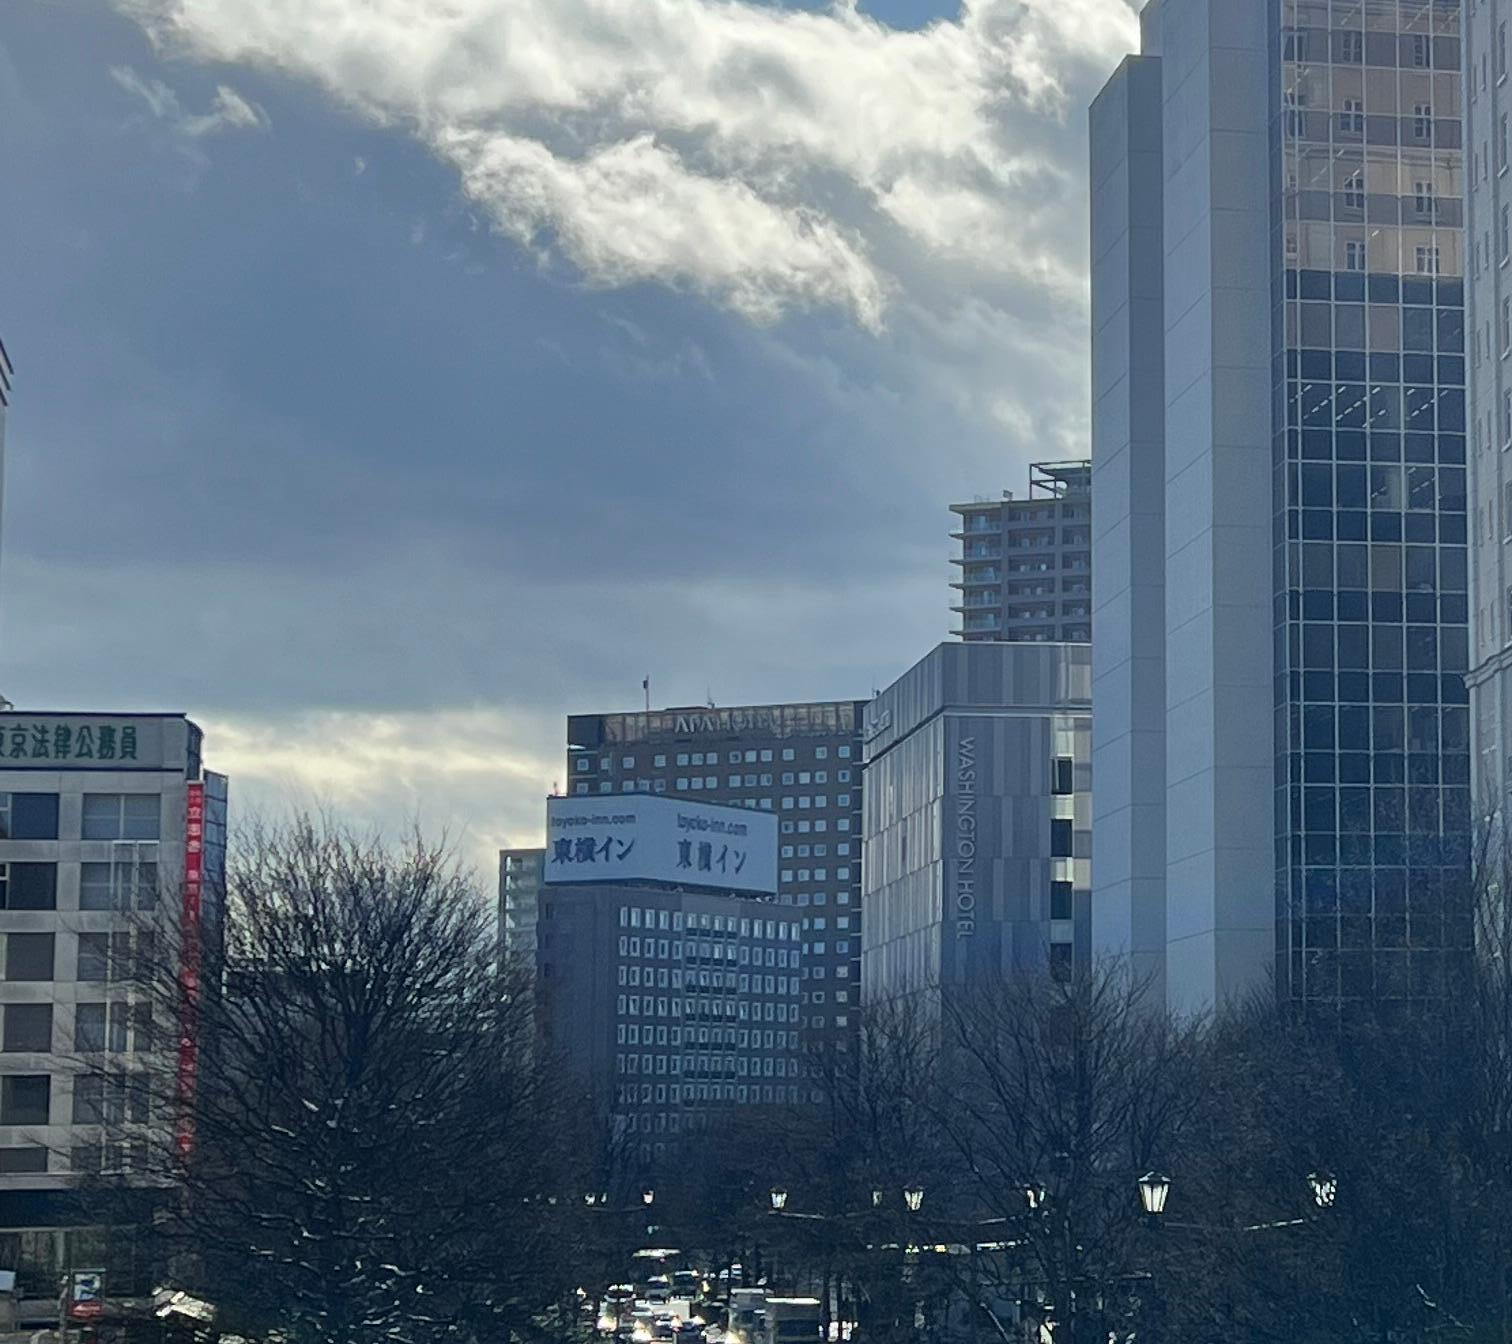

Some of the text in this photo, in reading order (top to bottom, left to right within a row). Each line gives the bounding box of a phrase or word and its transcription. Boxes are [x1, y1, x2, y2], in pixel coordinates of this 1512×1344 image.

[0, 723, 138, 760] 京法律公務員
[551, 835, 636, 866] 東横イン
[956, 736, 976, 939] WASHINGTON HOTEL
[675, 838, 747, 875] 東横イン
